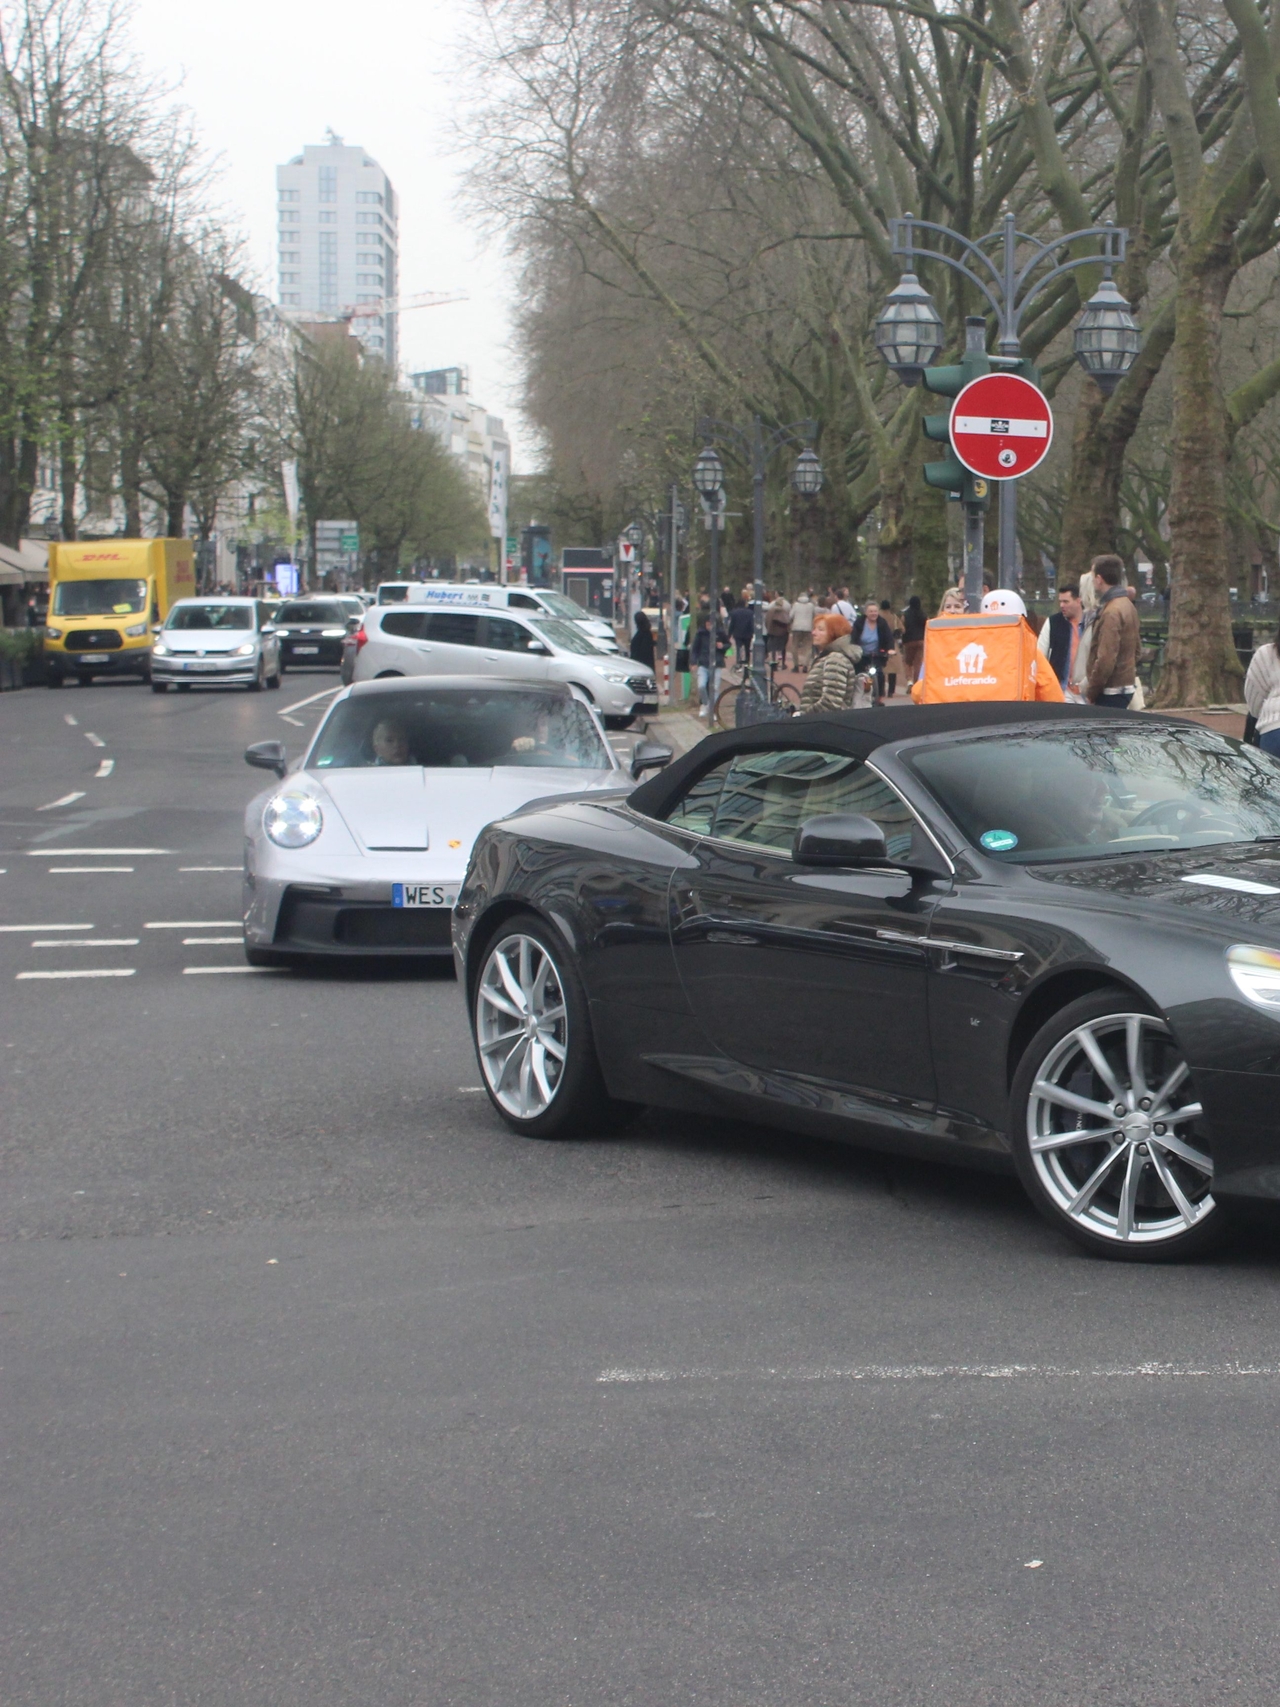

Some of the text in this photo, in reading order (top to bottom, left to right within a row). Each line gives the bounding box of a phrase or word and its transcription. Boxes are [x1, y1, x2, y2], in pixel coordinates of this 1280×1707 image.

[82, 553, 120, 561] DHL
[426, 590, 464, 600] Hubert
[944, 675, 997, 687] Lieferando
[405, 886, 444, 905] WES
